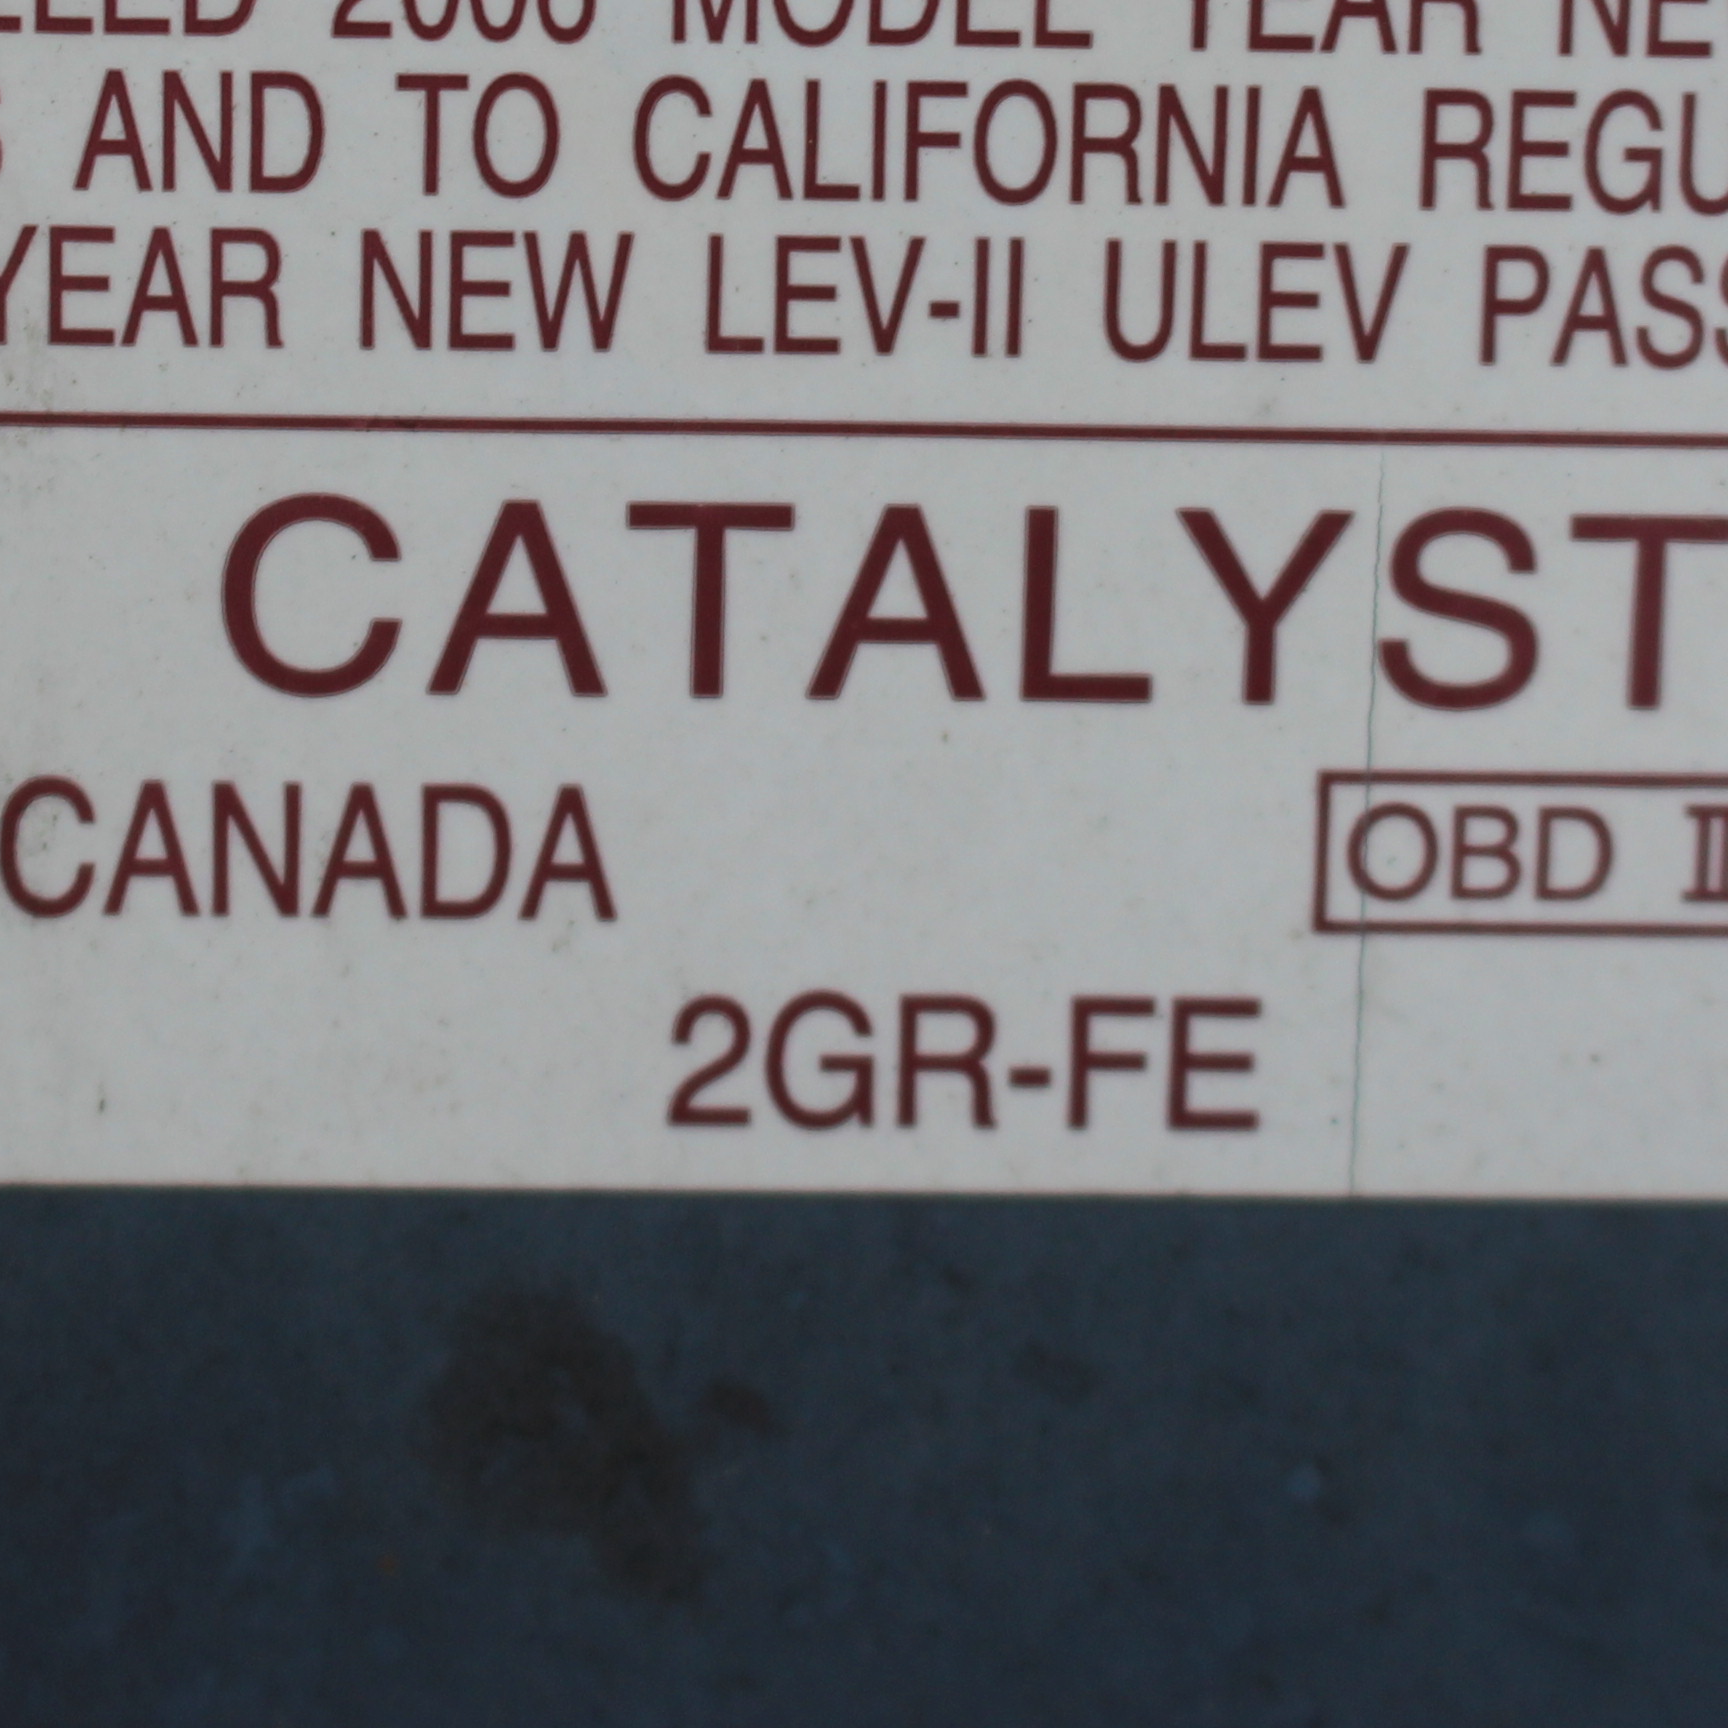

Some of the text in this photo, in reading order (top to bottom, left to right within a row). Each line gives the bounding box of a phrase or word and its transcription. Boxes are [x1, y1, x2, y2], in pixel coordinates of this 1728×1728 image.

[73, 69, 325, 193] AND
[395, 72, 560, 199] TO
[633, 75, 1345, 209] CALIFORNIA
[359, 229, 634, 352] NEW
[704, 234, 1024, 358] LEV-II
[1103, 239, 1410, 364] ULEV
[1347, 802, 1614, 902] OBD
[667, 989, 1262, 1132] 2GR-FE
